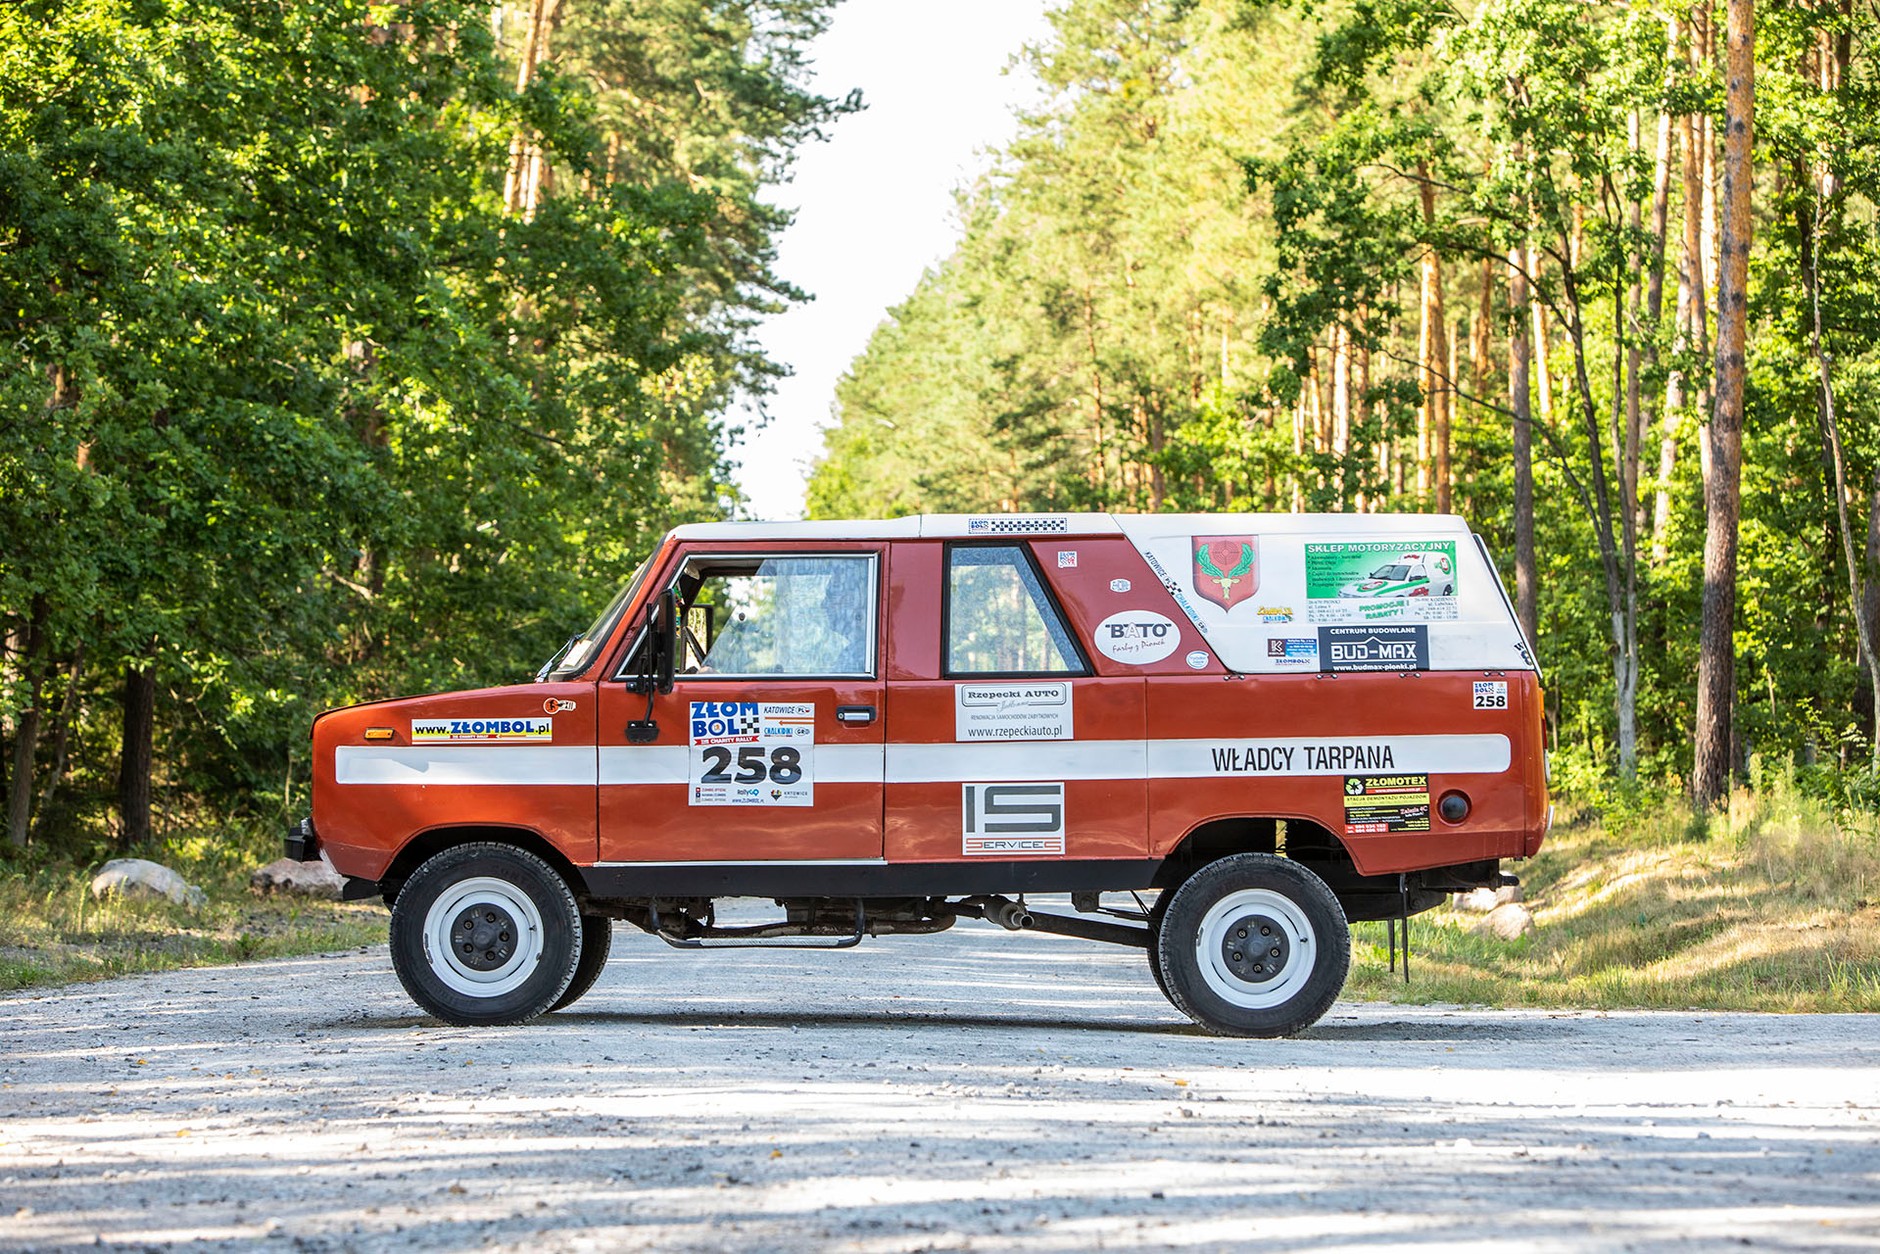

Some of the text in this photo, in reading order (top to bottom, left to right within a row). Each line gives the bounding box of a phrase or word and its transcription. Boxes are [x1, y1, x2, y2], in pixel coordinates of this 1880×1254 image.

[1308, 542, 1450, 553] SKLEP MOTORYZACYJNY
[1145, 551, 1167, 577] KATOWICE
[1359, 600, 1405, 612] PROMOCJE
[1365, 610, 1400, 619] RABATY
[1110, 622, 1167, 638] BATO
[1331, 644, 1417, 660] BUD-MAX
[968, 690, 1059, 699] Rzepecki AUTO
[1475, 696, 1506, 707] 258
[692, 702, 759, 719] ZŁOM
[764, 706, 795, 714] KATOWICE
[415, 720, 549, 735] www.ZŁOMBOL.pl
[693, 719, 740, 737] BOL
[968, 724, 1062, 738] www.rzepeckiauto.pl
[701, 746, 802, 784] 258
[1212, 745, 1395, 771] WŁADCY TARPANA
[1365, 777, 1426, 786] ZŁOMOTEX
[966, 837, 1061, 853] SERVICES
